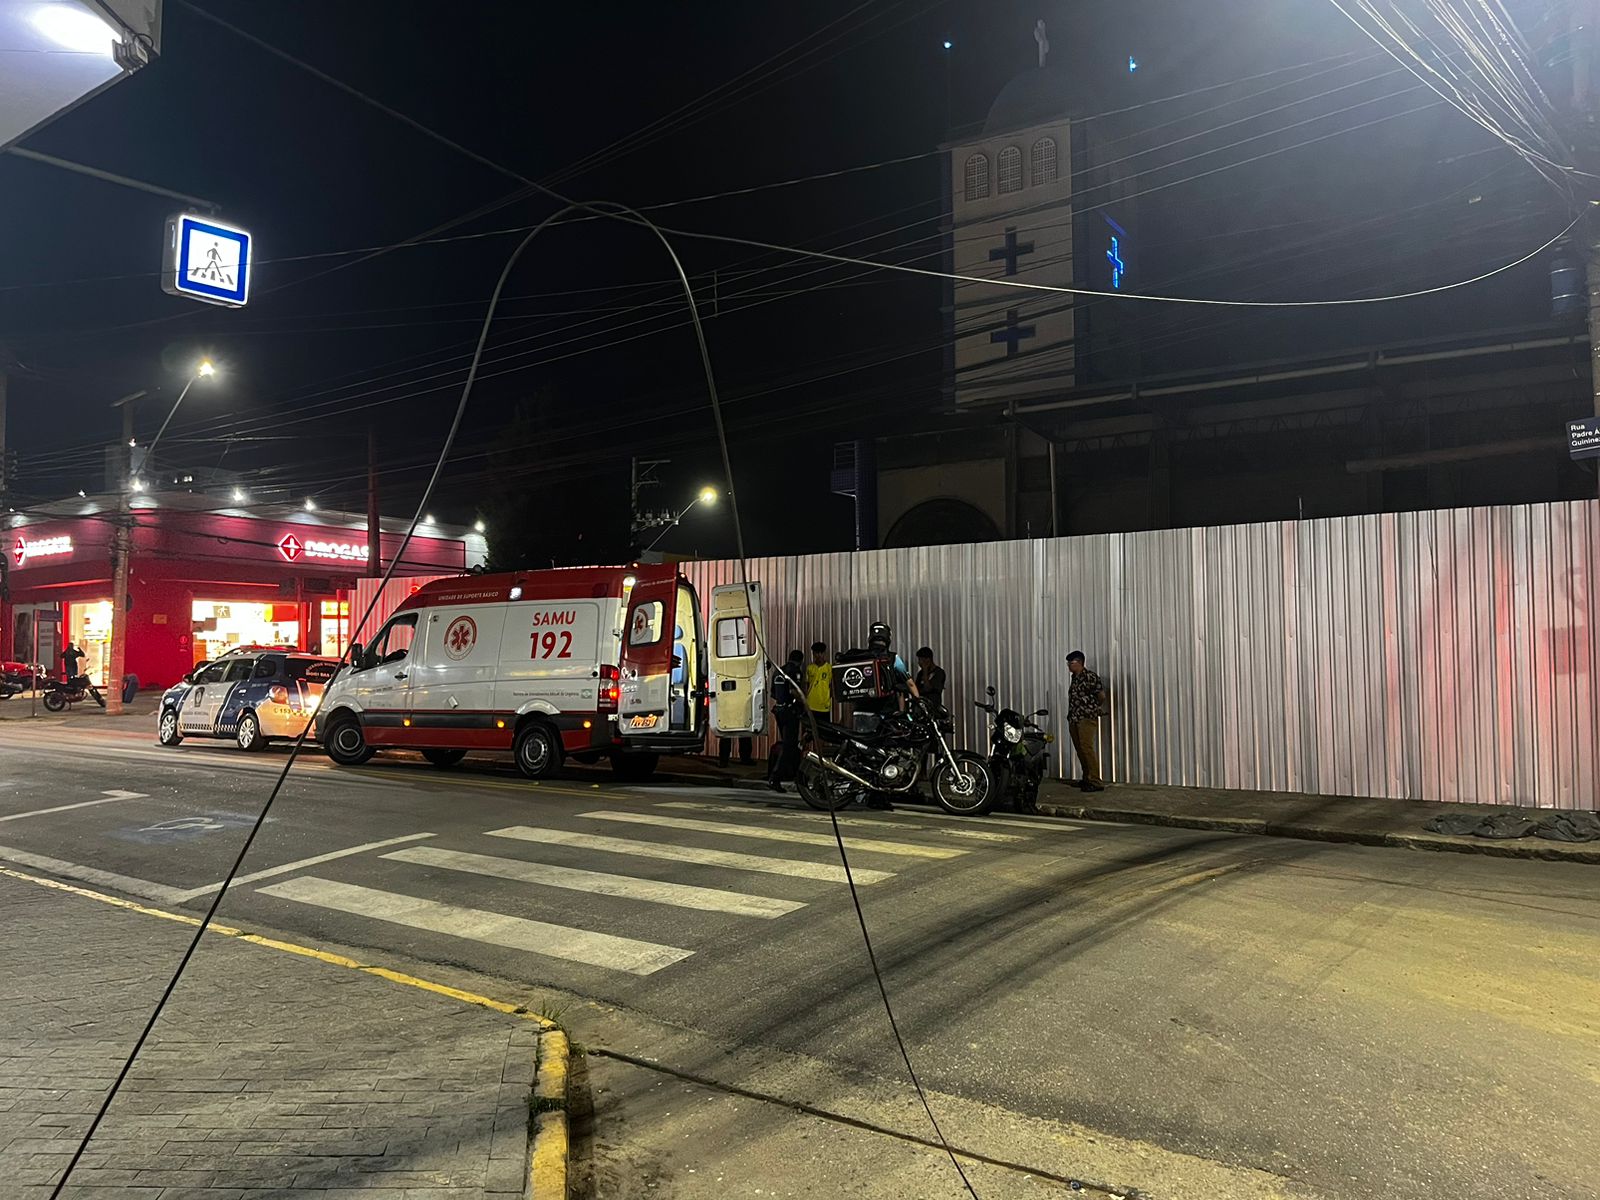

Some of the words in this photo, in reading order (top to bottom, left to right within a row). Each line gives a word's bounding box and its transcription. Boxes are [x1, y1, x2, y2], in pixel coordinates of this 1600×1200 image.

[1571, 431, 1593, 439] Padre
[305, 540, 369, 561] DROGAS
[532, 610, 577, 627] SAMU
[530, 630, 573, 660] 192
